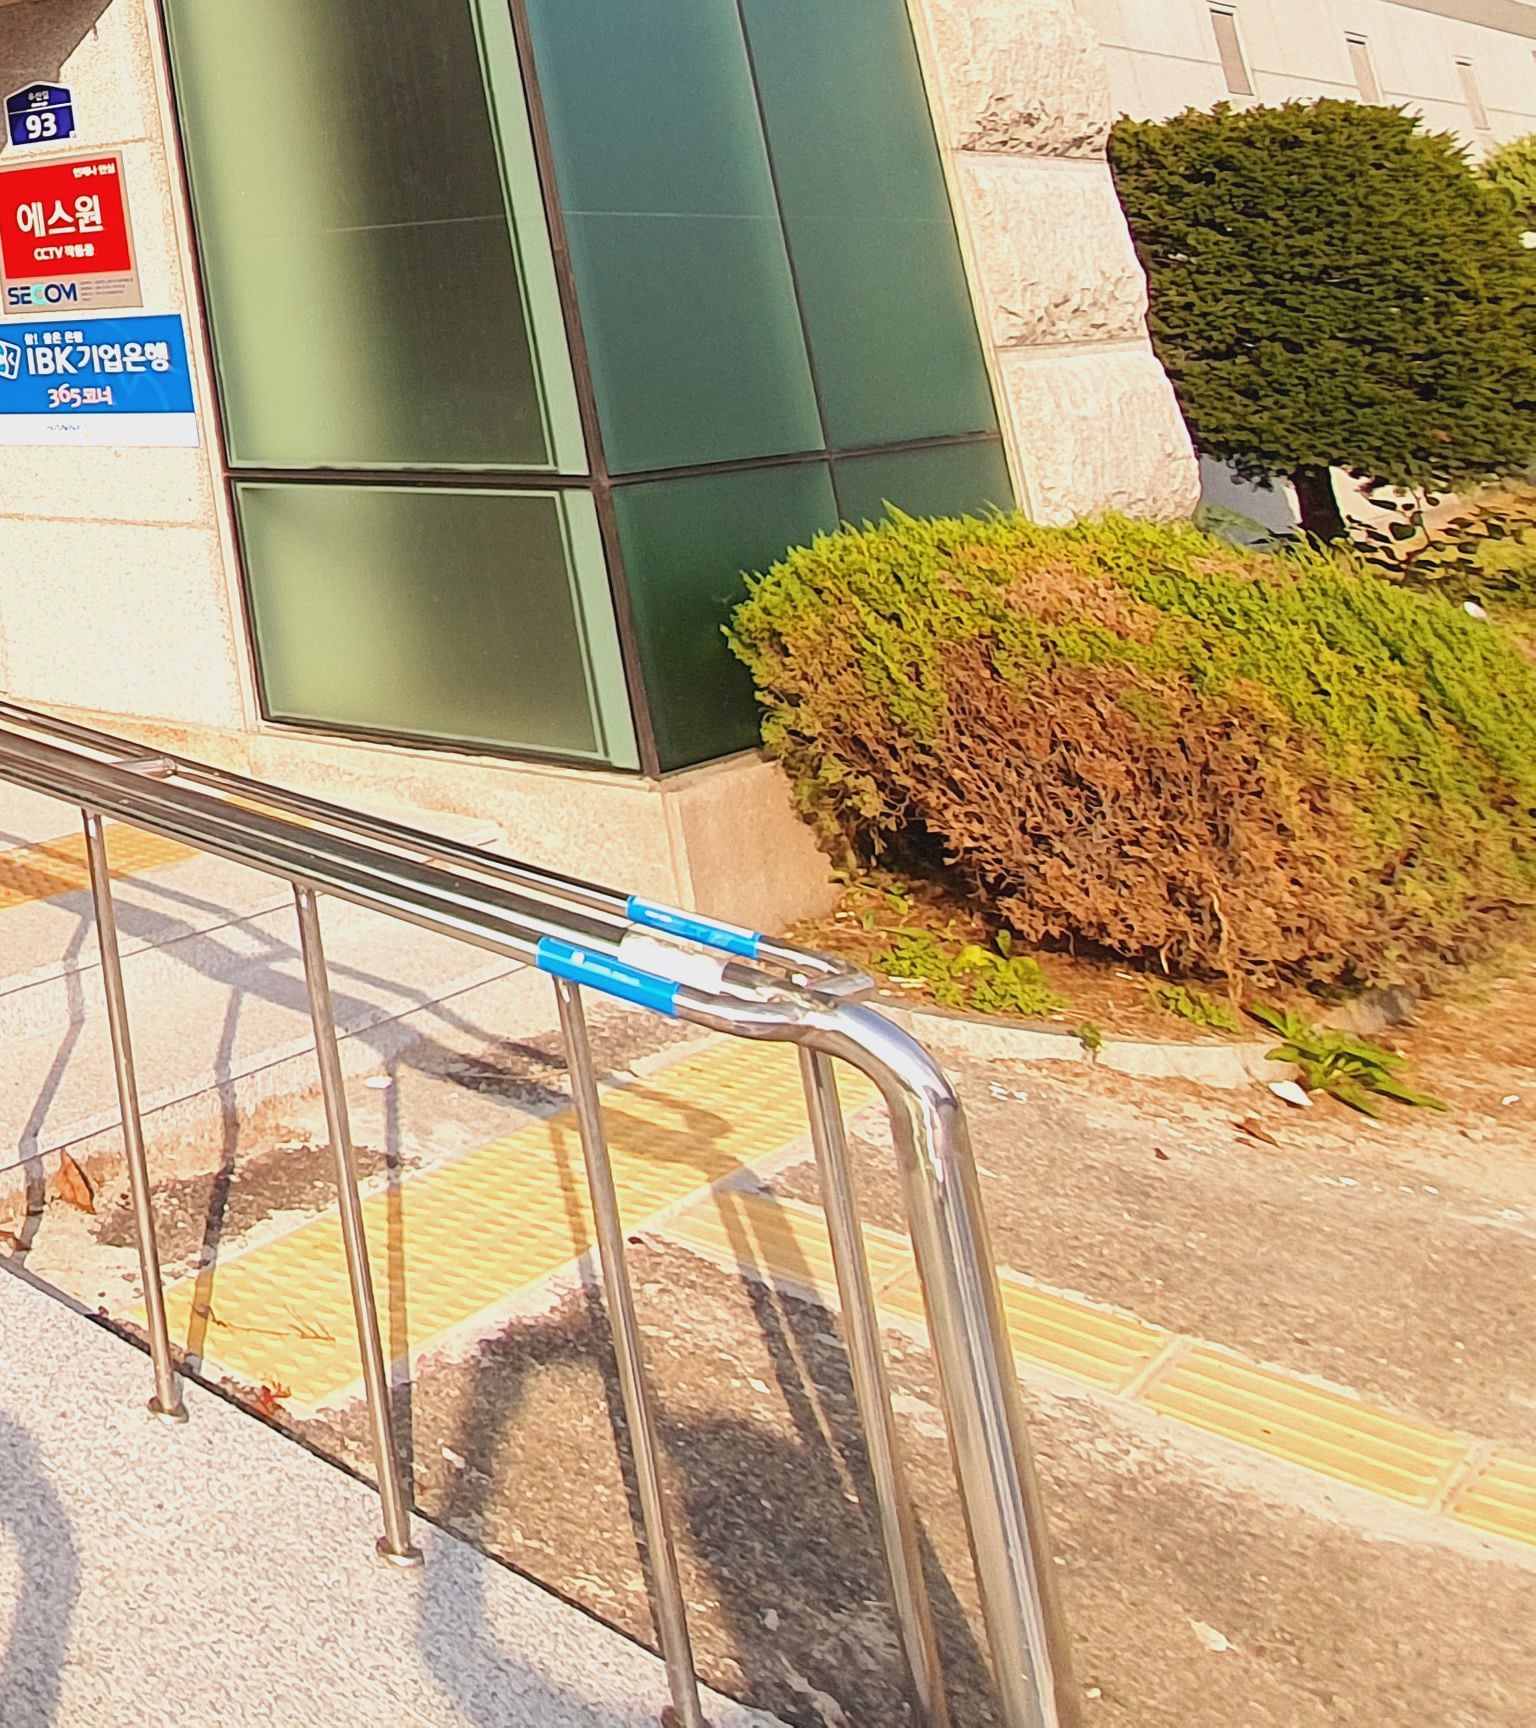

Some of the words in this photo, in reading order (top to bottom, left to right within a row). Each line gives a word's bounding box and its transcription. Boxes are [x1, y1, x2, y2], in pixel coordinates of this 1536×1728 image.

[26, 112, 57, 139] 93
[16, 194, 104, 238] 에스원
[33, 246, 63, 261] CCTV
[8, 282, 77, 306] SECOM
[27, 341, 170, 375] IBK기업은행
[47, 383, 114, 408] 365코너
